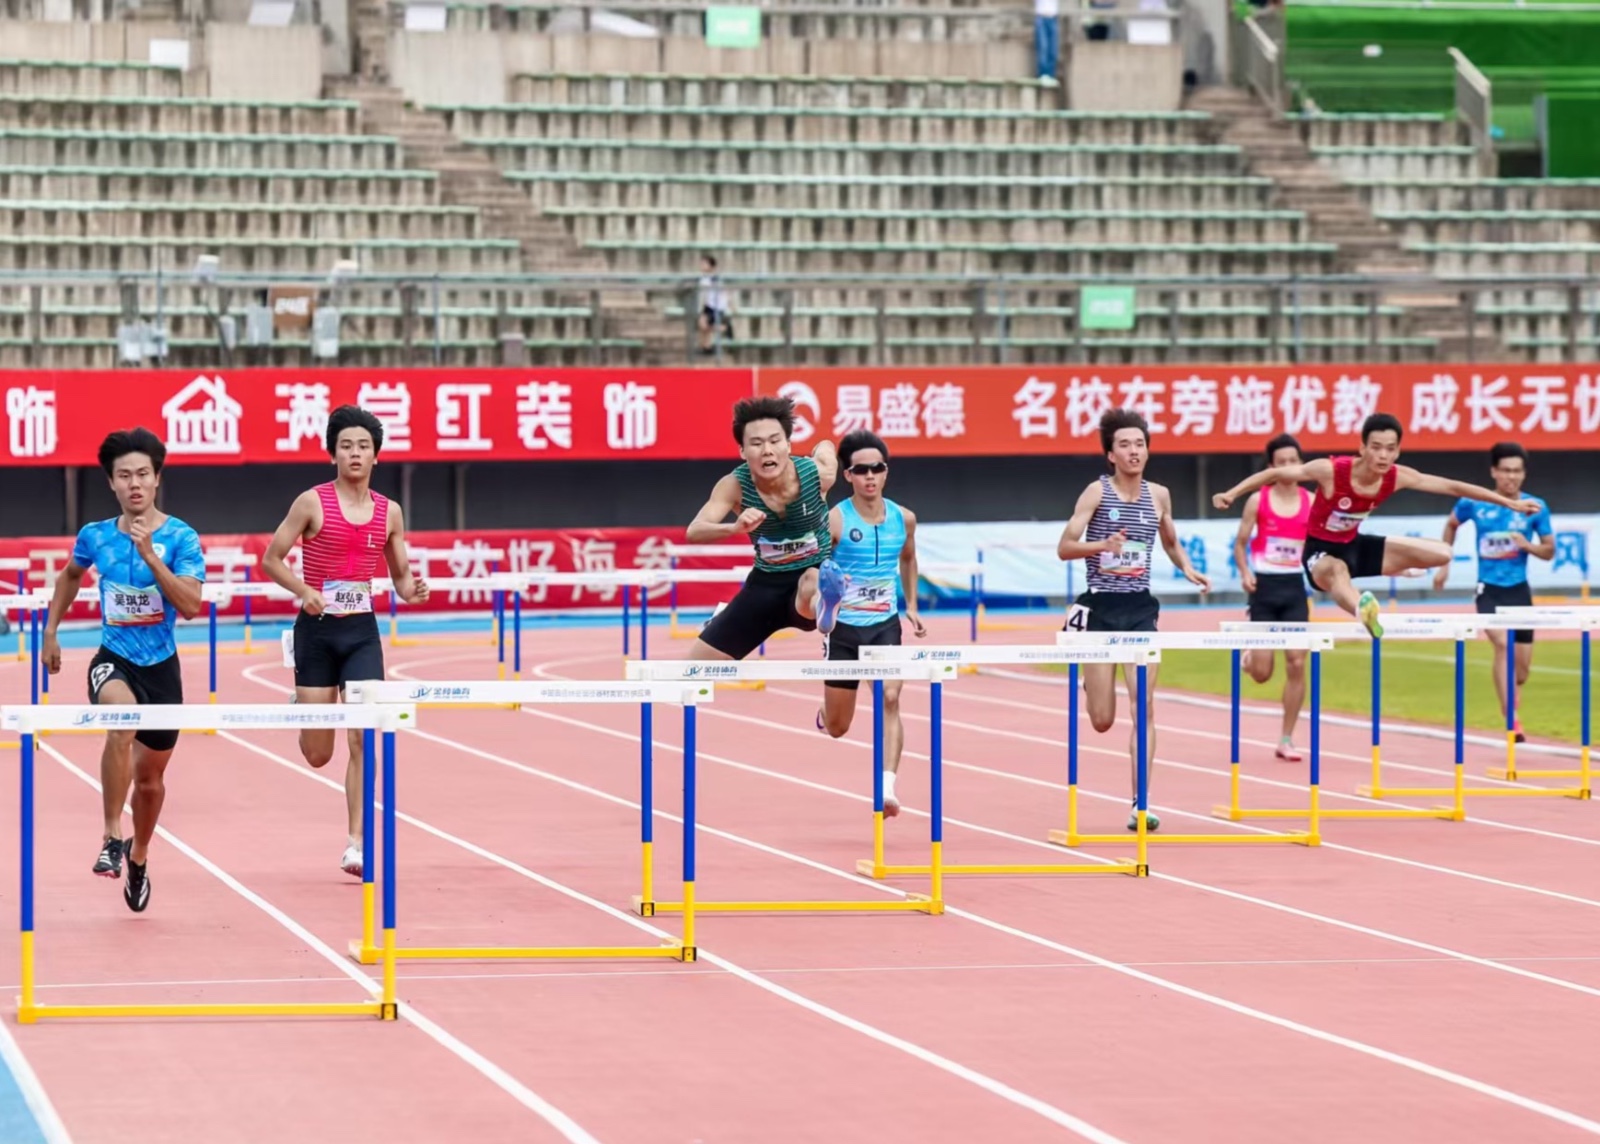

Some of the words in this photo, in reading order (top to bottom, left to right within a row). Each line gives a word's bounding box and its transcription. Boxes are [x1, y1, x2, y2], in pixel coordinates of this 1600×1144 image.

[7, 386, 57, 456] 饰
[275, 381, 657, 452] 满堂红装饰
[832, 383, 966, 438] 易盛德
[1011, 374, 1383, 438] 名校在旁施优教
[1069, 609, 1085, 632] 4
